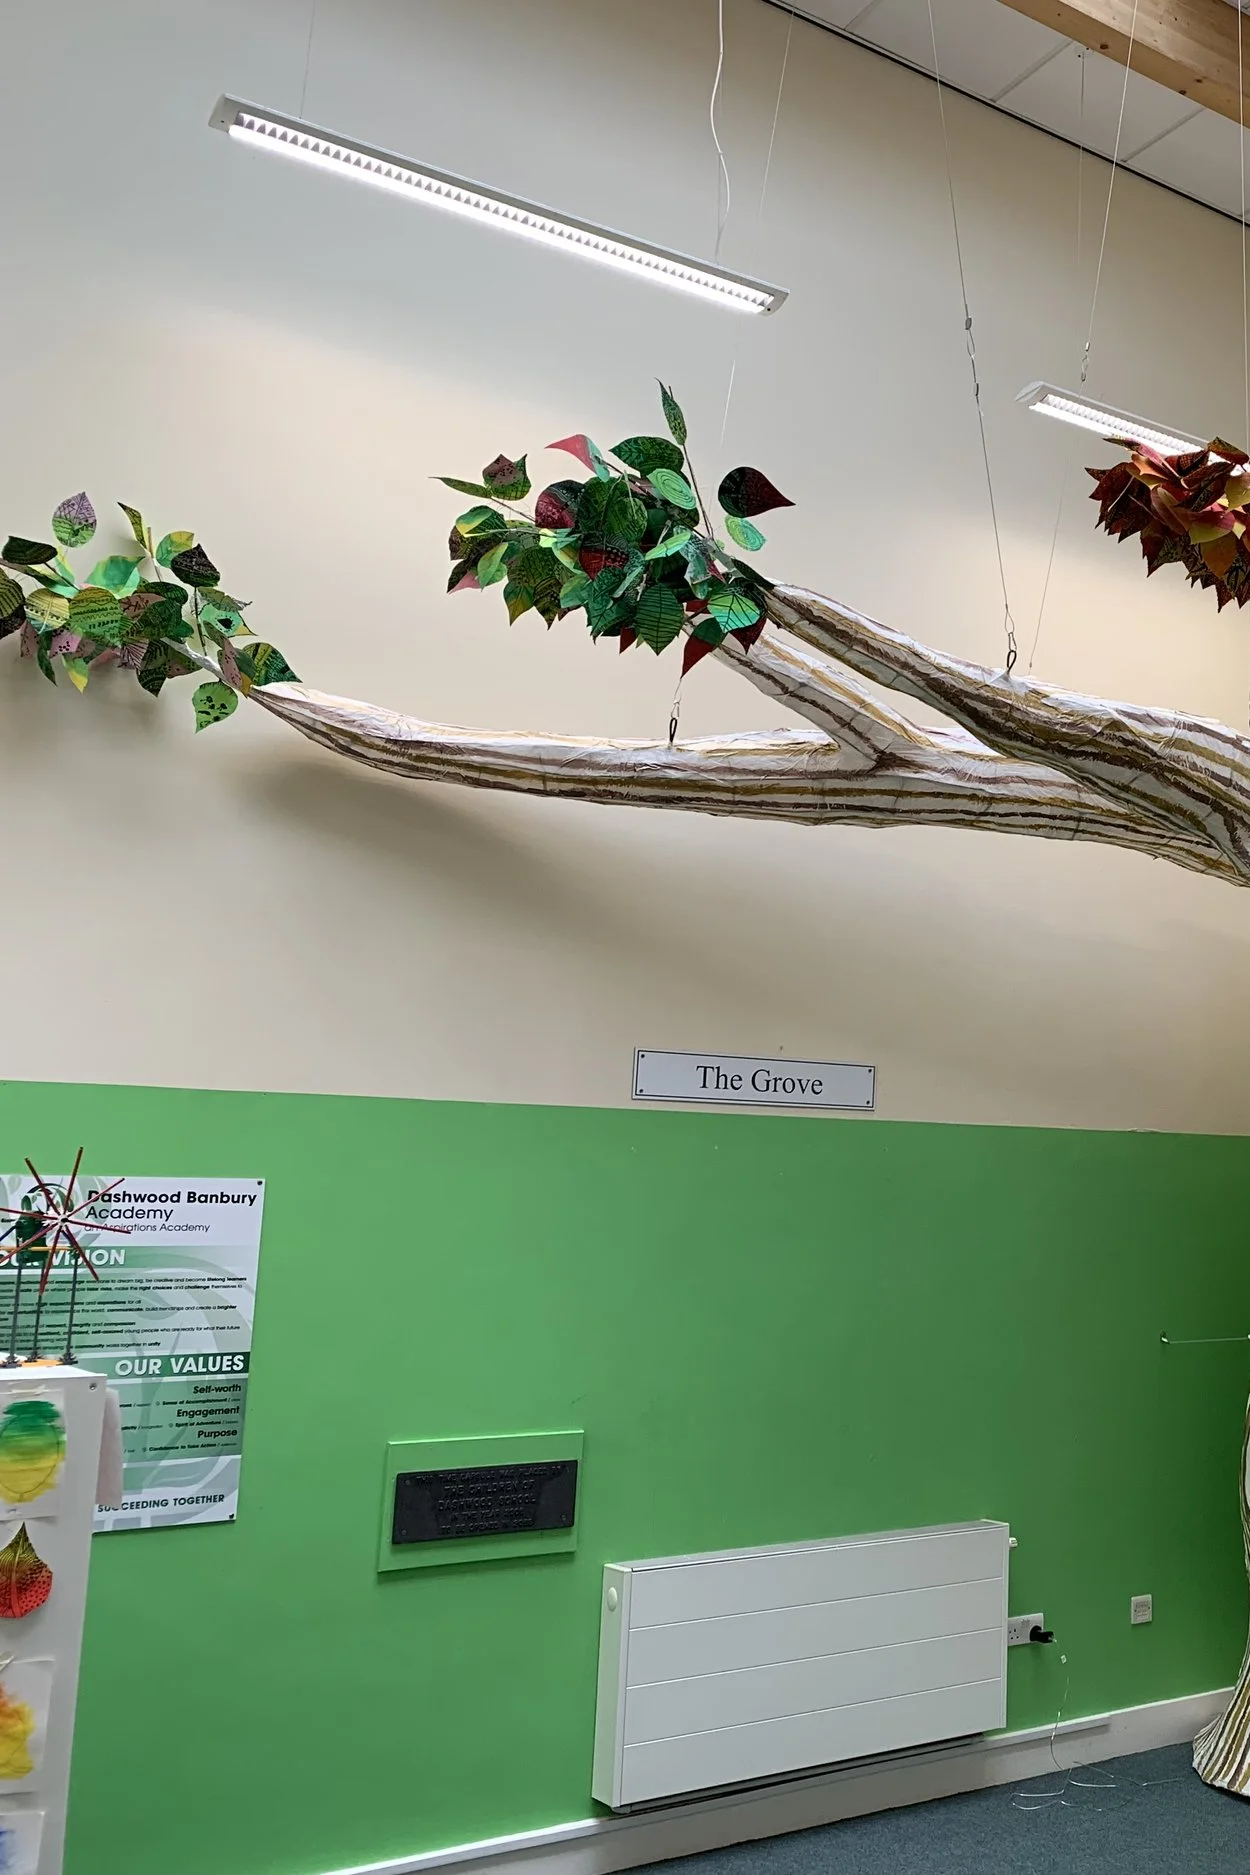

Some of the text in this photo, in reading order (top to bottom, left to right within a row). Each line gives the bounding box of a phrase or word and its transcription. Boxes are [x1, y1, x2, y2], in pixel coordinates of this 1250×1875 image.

[696, 1065, 823, 1096] The Grove
[88, 1190, 257, 1206] Dashwood Banbury
[85, 1206, 174, 1221] Academy
[102, 1222, 157, 1233] Aspirations
[159, 1222, 210, 1232] Academy
[115, 1355, 244, 1376] OUR VALUES
[193, 1384, 242, 1394] Self-worth
[176, 1406, 240, 1418] Engagement
[197, 1430, 238, 1439] Purpose
[173, 1494, 225, 1507] TOGETHER
